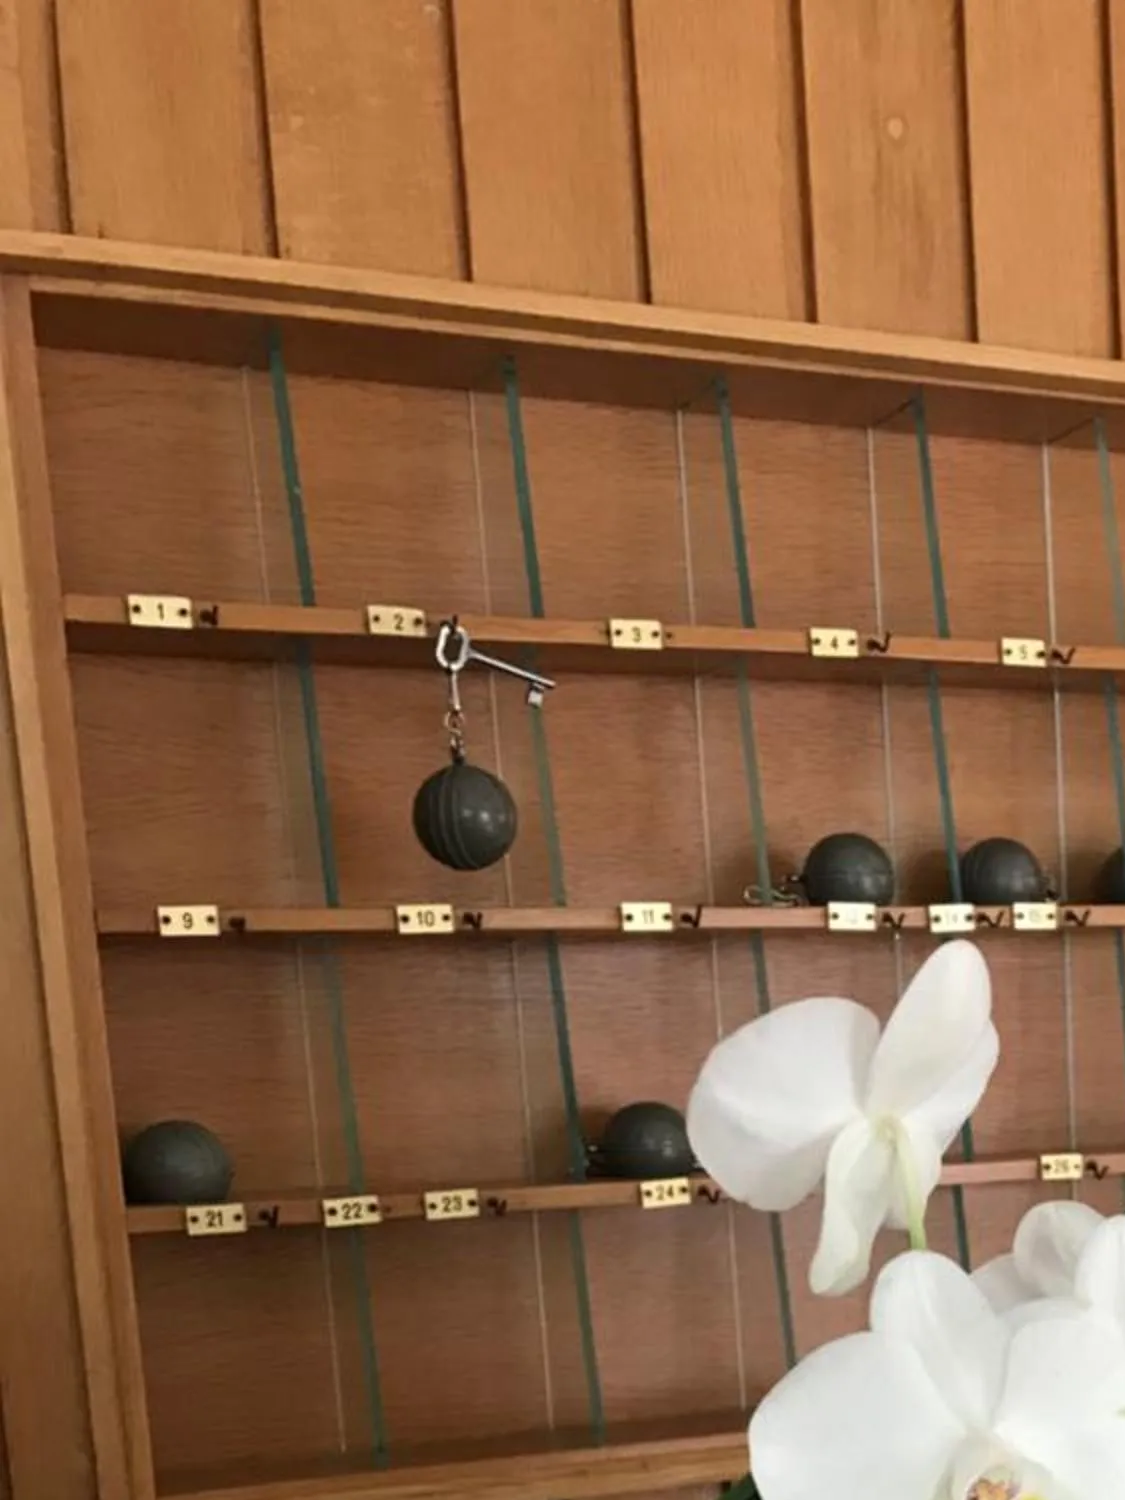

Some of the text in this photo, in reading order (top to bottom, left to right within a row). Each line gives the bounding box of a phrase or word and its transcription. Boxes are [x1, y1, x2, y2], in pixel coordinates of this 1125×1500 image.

[157, 603, 164, 621] 1
[393, 613, 404, 631] 2
[631, 626, 642, 643] 3
[830, 635, 840, 650] 4
[182, 912, 194, 929] 9
[417, 910, 435, 927] 10
[641, 909, 655, 924] 11
[655, 1184, 675, 1201] 24
[341, 1202, 363, 1220] 22
[441, 1195, 463, 1212] 23
[205, 1210, 223, 1228] 21
